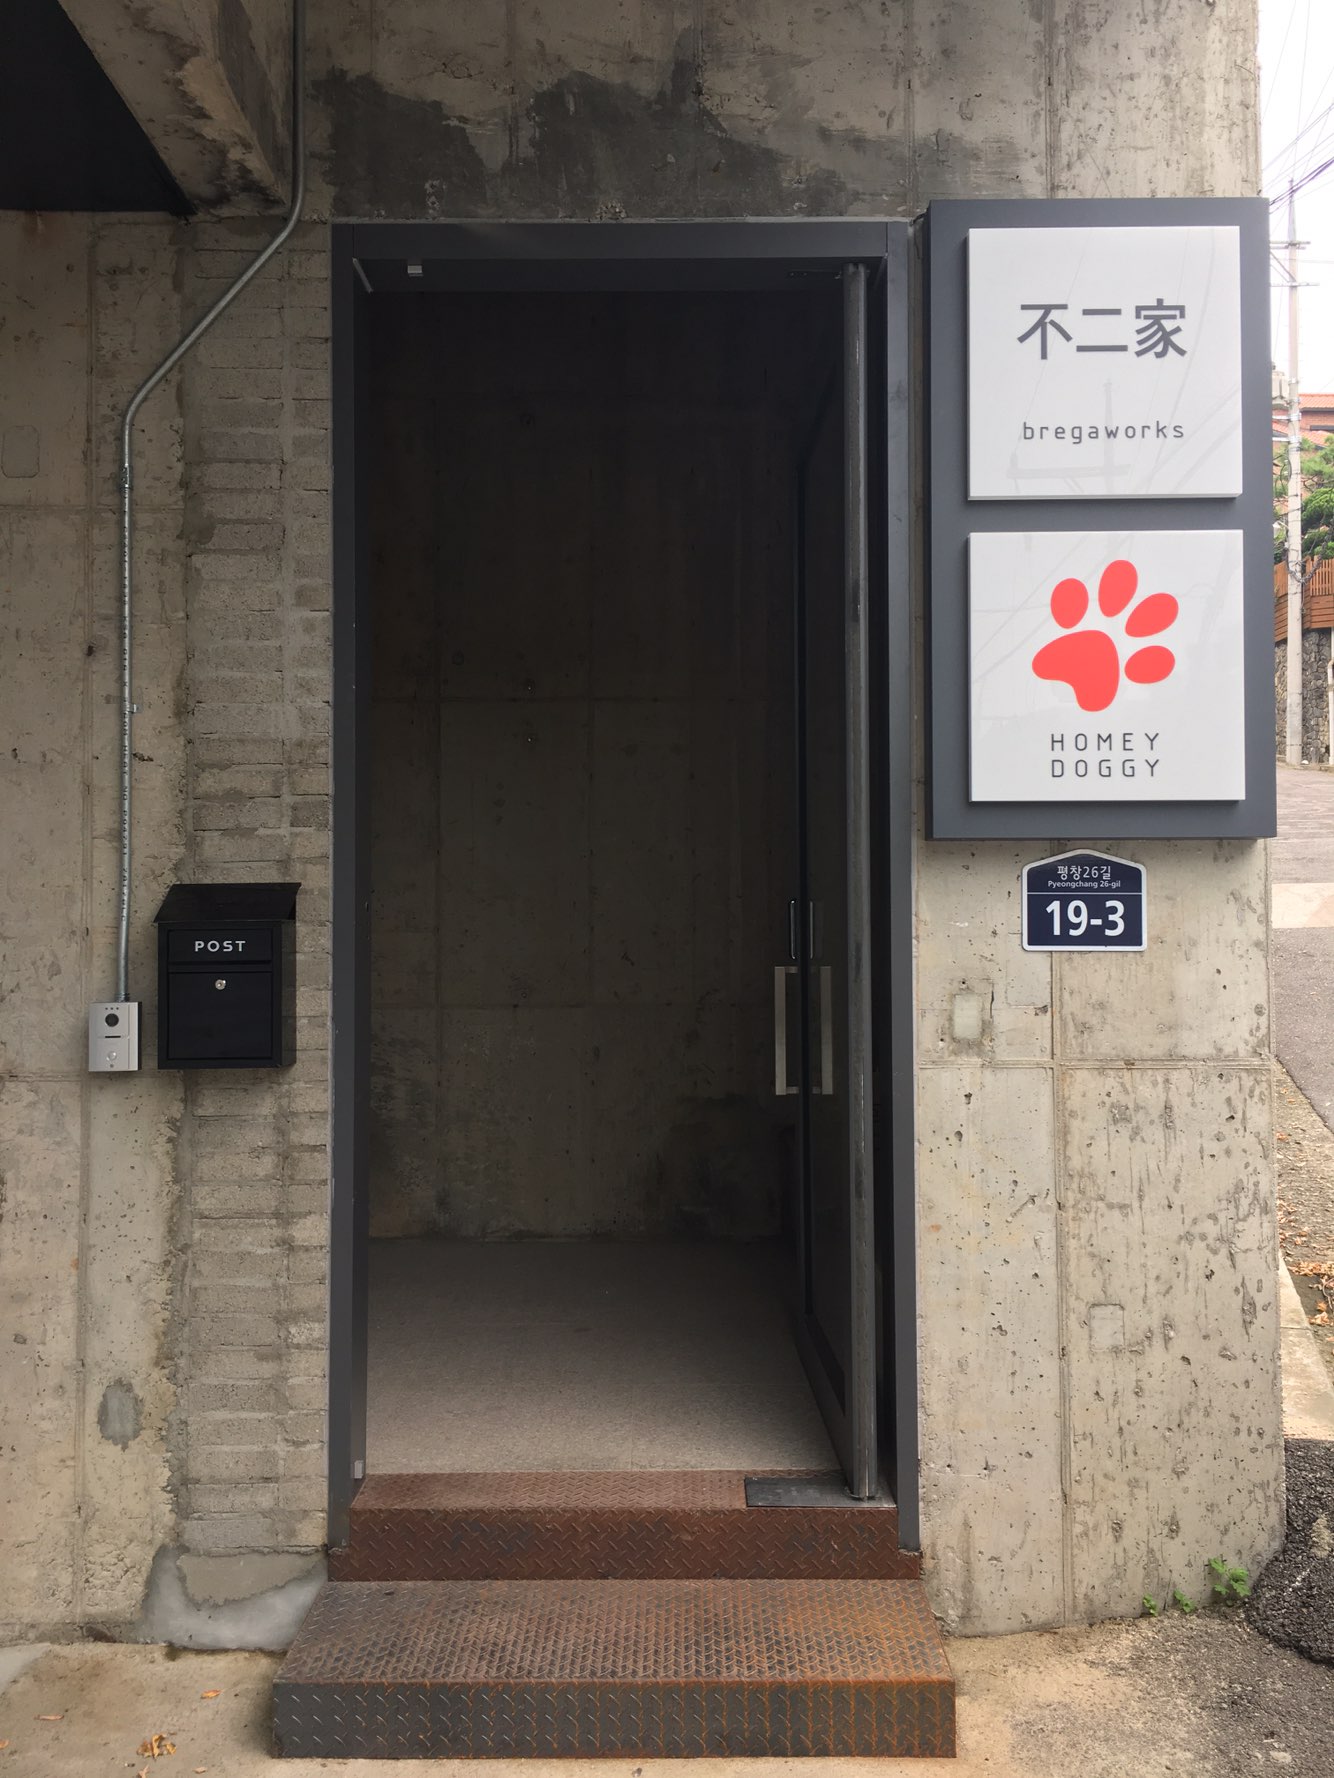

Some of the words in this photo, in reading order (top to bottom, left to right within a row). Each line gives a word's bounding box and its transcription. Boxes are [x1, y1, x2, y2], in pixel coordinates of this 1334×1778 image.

[1016, 298, 1187, 360] 不二家
[1022, 420, 1184, 444] bregaworks
[1051, 732, 1160, 751] HOMEY
[1051, 759, 1160, 778] DOGGY
[1057, 865, 1111, 880] 평창26길
[1047, 880, 1098, 889] Pyeongchang
[1099, 880, 1121, 889] 26-gil
[1045, 899, 1125, 937] 19-3
[194, 940, 246, 952] POST
